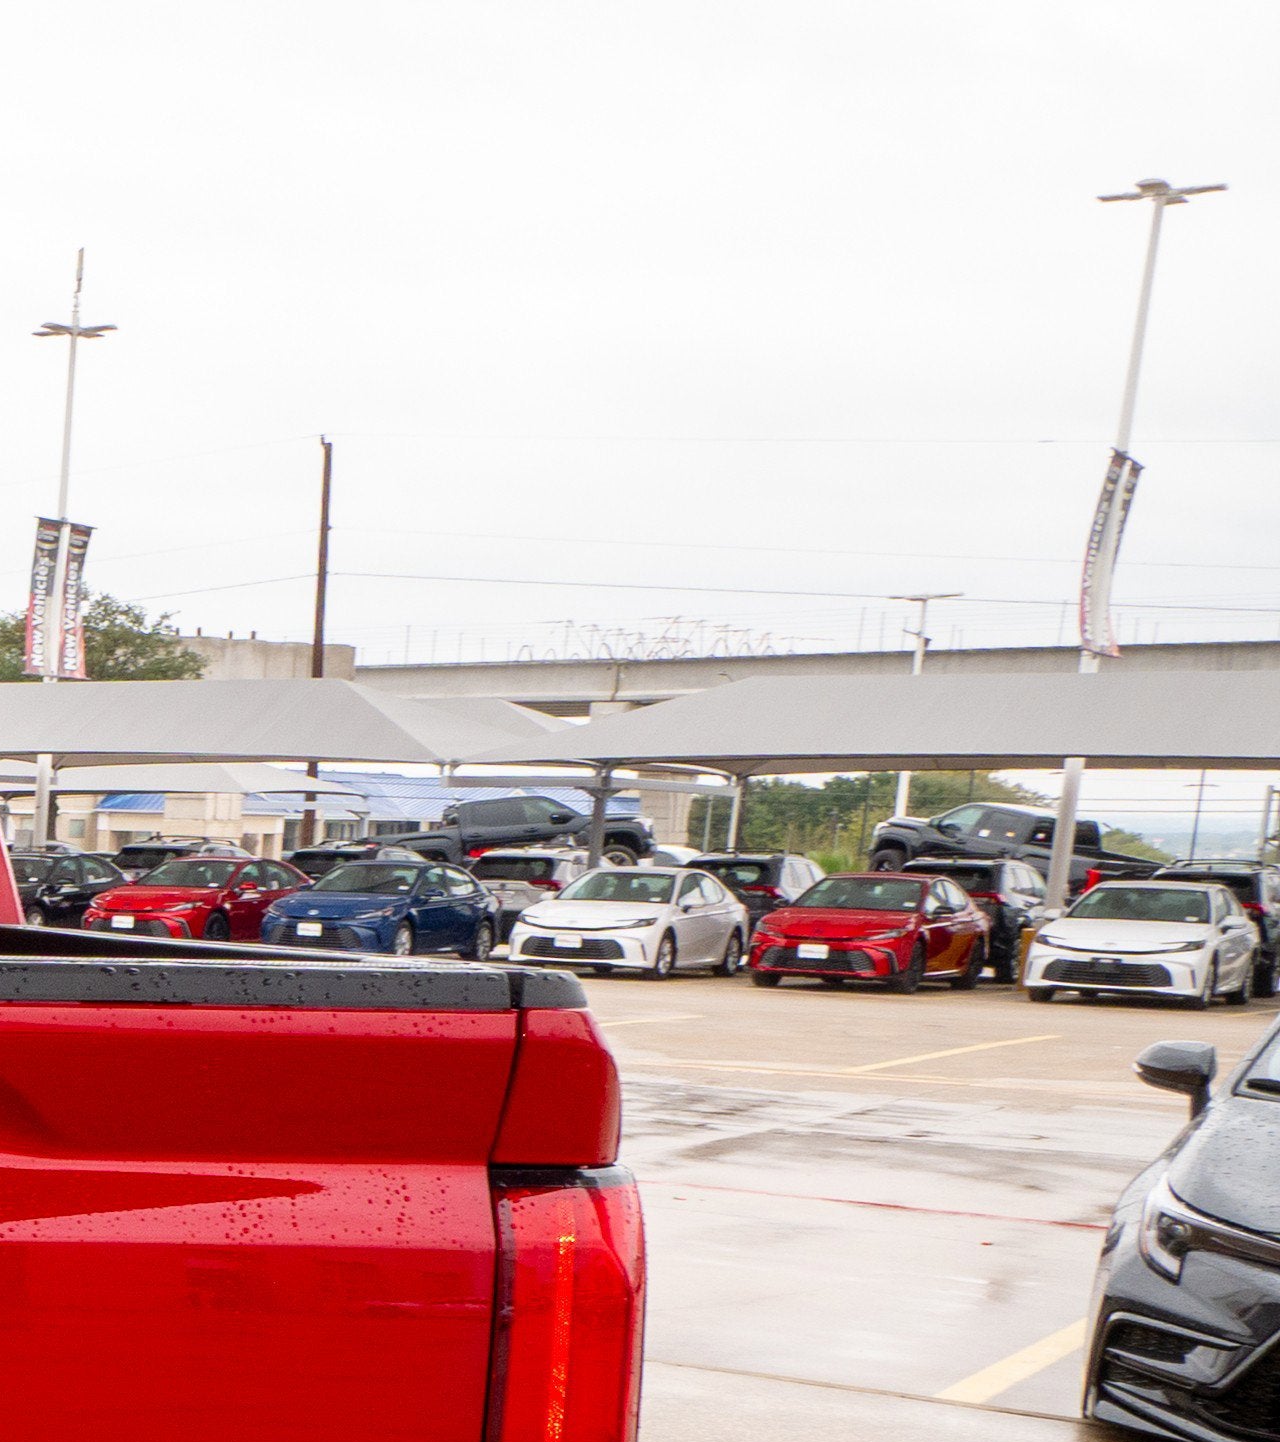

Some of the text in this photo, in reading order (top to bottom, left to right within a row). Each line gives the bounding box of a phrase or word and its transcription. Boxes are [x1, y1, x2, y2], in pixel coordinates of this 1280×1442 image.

[32, 556, 50, 628] Vehicles
[63, 561, 80, 671] New Vehicles
[31, 630, 45, 667] New
